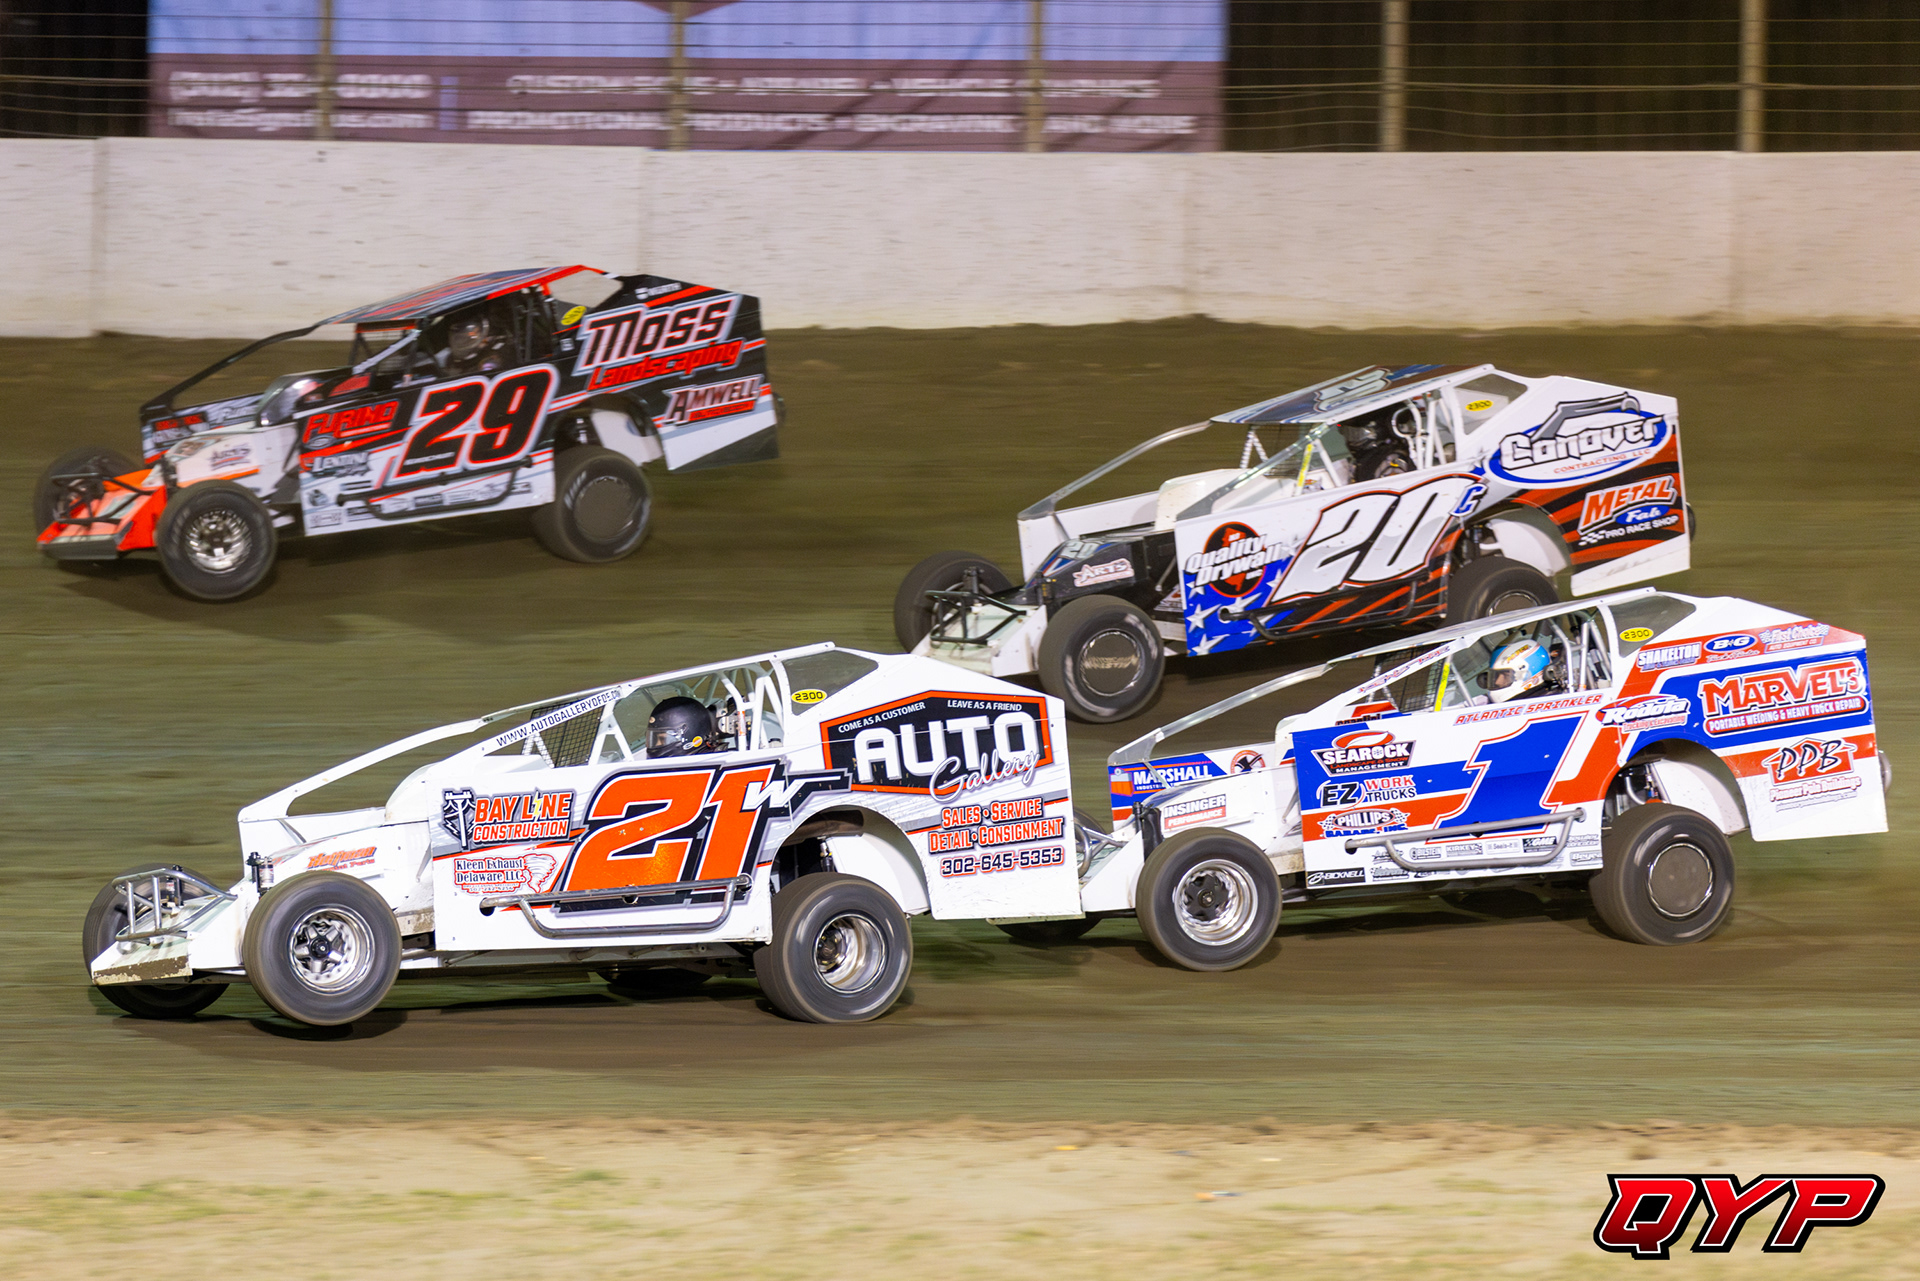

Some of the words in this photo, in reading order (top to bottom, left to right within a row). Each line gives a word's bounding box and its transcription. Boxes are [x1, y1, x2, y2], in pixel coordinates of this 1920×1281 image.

[587, 339, 744, 391] Landscaping
[663, 376, 763, 422] AMWELL
[394, 366, 556, 478] 29
[1499, 414, 1664, 470] Conover
[1553, 453, 1627, 474] CONTRACTING
[1632, 448, 1651, 457] LLC
[1580, 478, 1674, 529] METAL
[1625, 507, 1662, 523] Fab
[1604, 528, 1626, 540] PRO
[1626, 522, 1652, 534] RACE
[1652, 516, 1680, 528] SHOP
[1060, 541, 1100, 560] 20
[1185, 534, 1267, 572] Quality
[1194, 542, 1282, 587] Drywall
[1623, 629, 1650, 640] 2300
[1638, 643, 1701, 666] SHAKELTON
[794, 691, 824, 701] 2300
[1702, 661, 1862, 715] MARVEL'S
[838, 719, 863, 733] COME
[863, 717, 875, 727] AS
[875, 715, 882, 723] A
[882, 701, 926, 720] CUSTOMER
[947, 700, 973, 709] LEAVE
[973, 701, 985, 710] AS
[992, 702, 1022, 711] FRIEND
[1454, 705, 1522, 725] ATLANTIC
[1526, 695, 1603, 714] SPRINKLER
[1709, 716, 1746, 731] PORTABLE
[1746, 711, 1779, 725] WELDING
[1787, 706, 1810, 719] HEAVY
[1810, 701, 1835, 714] TRUCK
[1835, 698, 1862, 711] REPAIR
[854, 711, 1040, 784] AUTO
[1322, 743, 1410, 765] SEAROCK
[1777, 740, 1842, 778] PPB
[1330, 758, 1377, 769] LANDSCAPE
[1384, 756, 1409, 764] SNOW
[1336, 761, 1404, 773] MANAGEMENT
[930, 748, 1040, 802] Gallery
[1134, 765, 1213, 785] MARSHALL
[1366, 776, 1414, 790] WORK
[1426, 711, 1590, 844] 1
[1321, 783, 1359, 807] EZ
[1366, 787, 1416, 802] TRUCKS
[475, 796, 519, 823] BAY
[942, 806, 981, 827] SALES
[990, 798, 1042, 821] SERVICE
[1164, 796, 1226, 818] INSINGER
[1168, 809, 1223, 827] PERFORMANCE
[1337, 811, 1391, 827] PHILLIPS
[473, 820, 568, 842] CONSTRUCTION
[929, 830, 973, 852] DETAIL
[978, 818, 1064, 846] CONSIGNMENT
[307, 846, 377, 869] Hoffman
[456, 860, 484, 870] Kleen
[487, 858, 523, 870] Exhaust
[942, 847, 1063, 875] 302-645-5353
[456, 872, 503, 883] Delaware
[505, 870, 524, 881] LLC.
